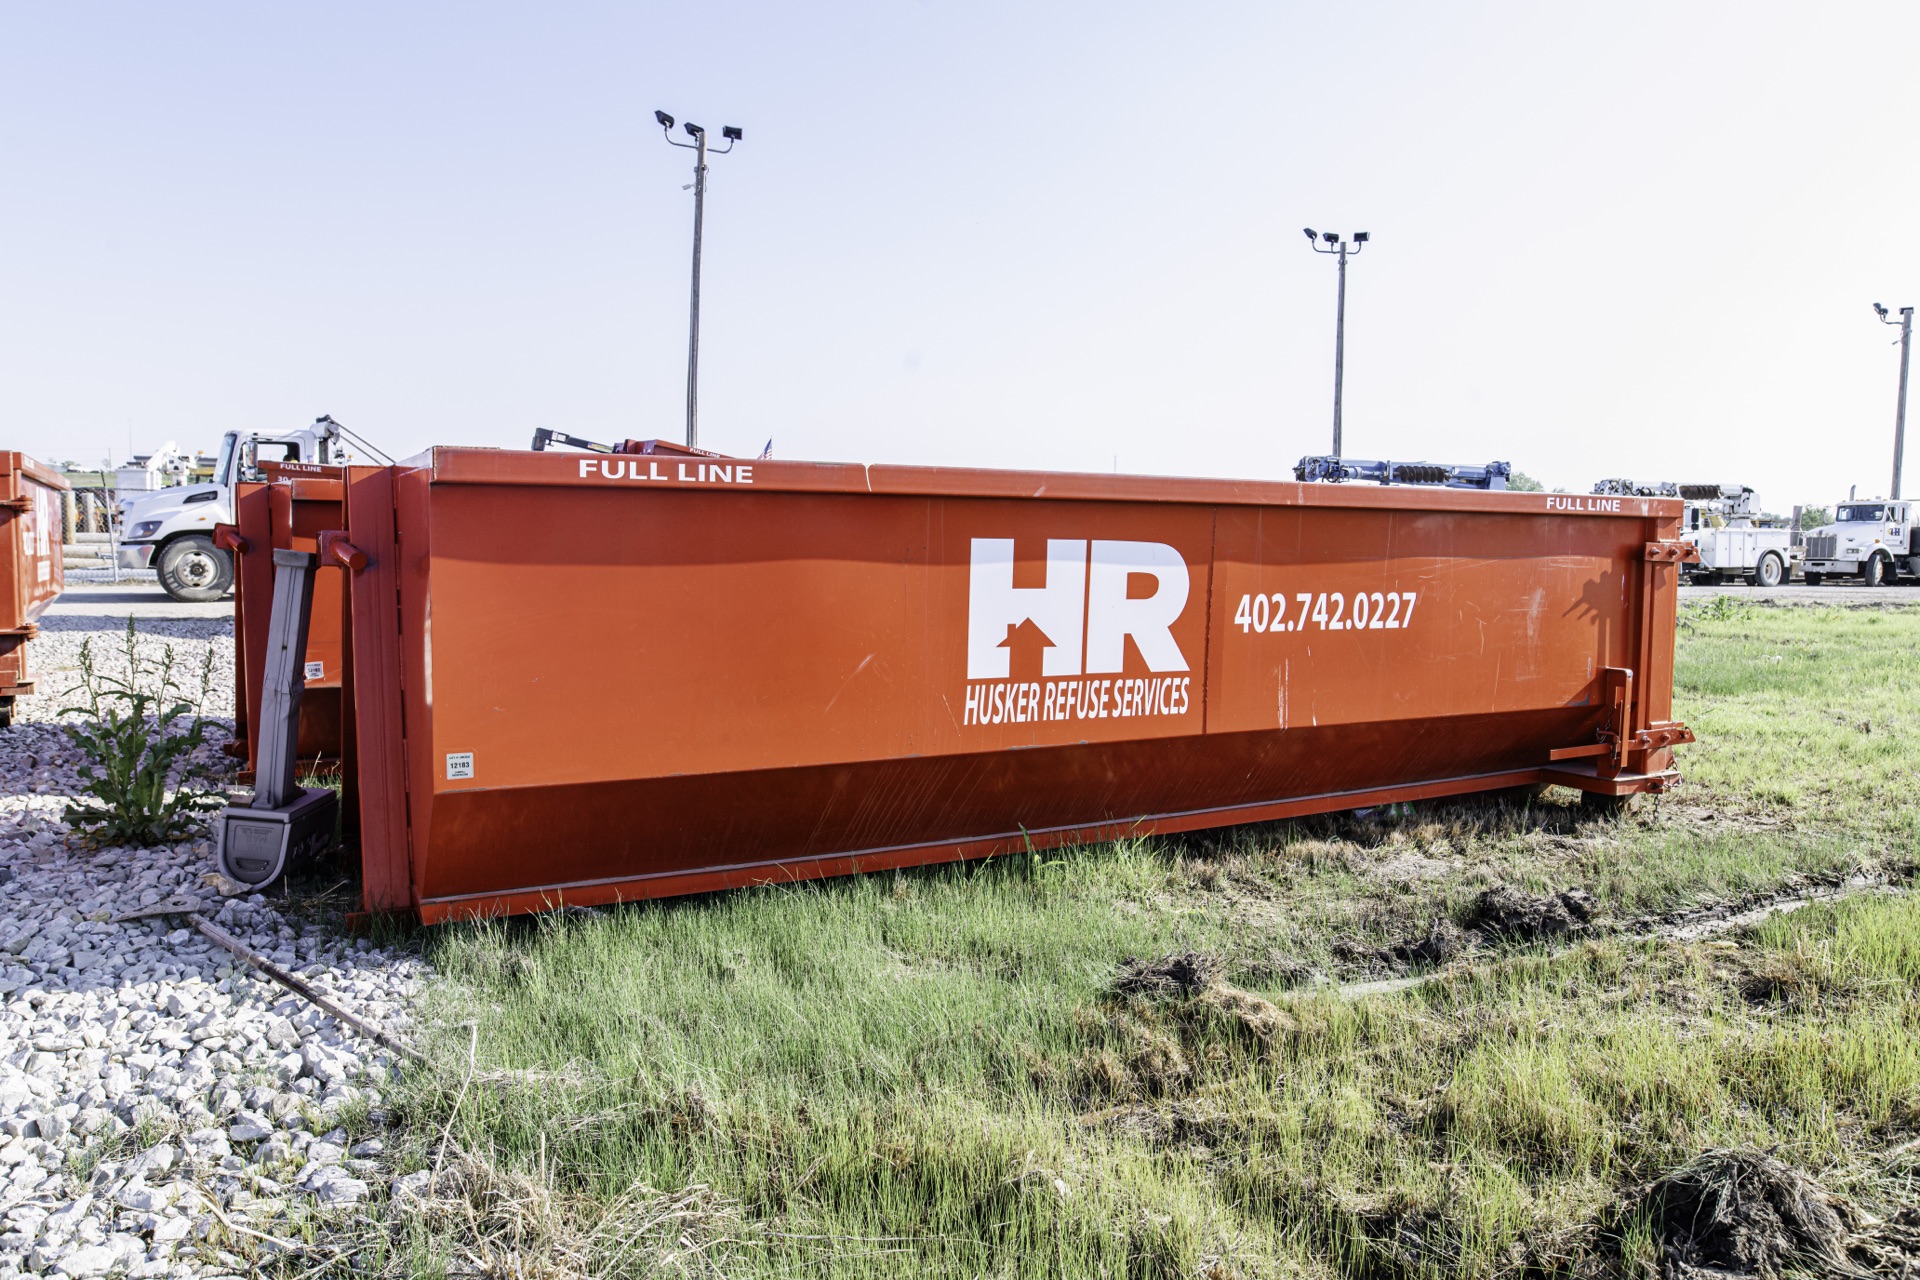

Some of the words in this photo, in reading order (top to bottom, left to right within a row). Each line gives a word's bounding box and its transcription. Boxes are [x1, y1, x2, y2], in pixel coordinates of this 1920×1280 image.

[689, 447, 706, 456] FULL
[280, 463, 301, 471] FULL
[302, 465, 322, 473] LINE
[579, 459, 668, 481] FULL
[678, 463, 753, 484] LINE
[1546, 497, 1584, 511] FULL
[1587, 498, 1621, 512] LINE
[967, 537, 1190, 680] HR
[1234, 591, 1417, 634] 402.742.0227
[963, 682, 1041, 726] HUSKER
[1043, 679, 1111, 721] REFUSE
[1112, 676, 1190, 717] SERVICES
